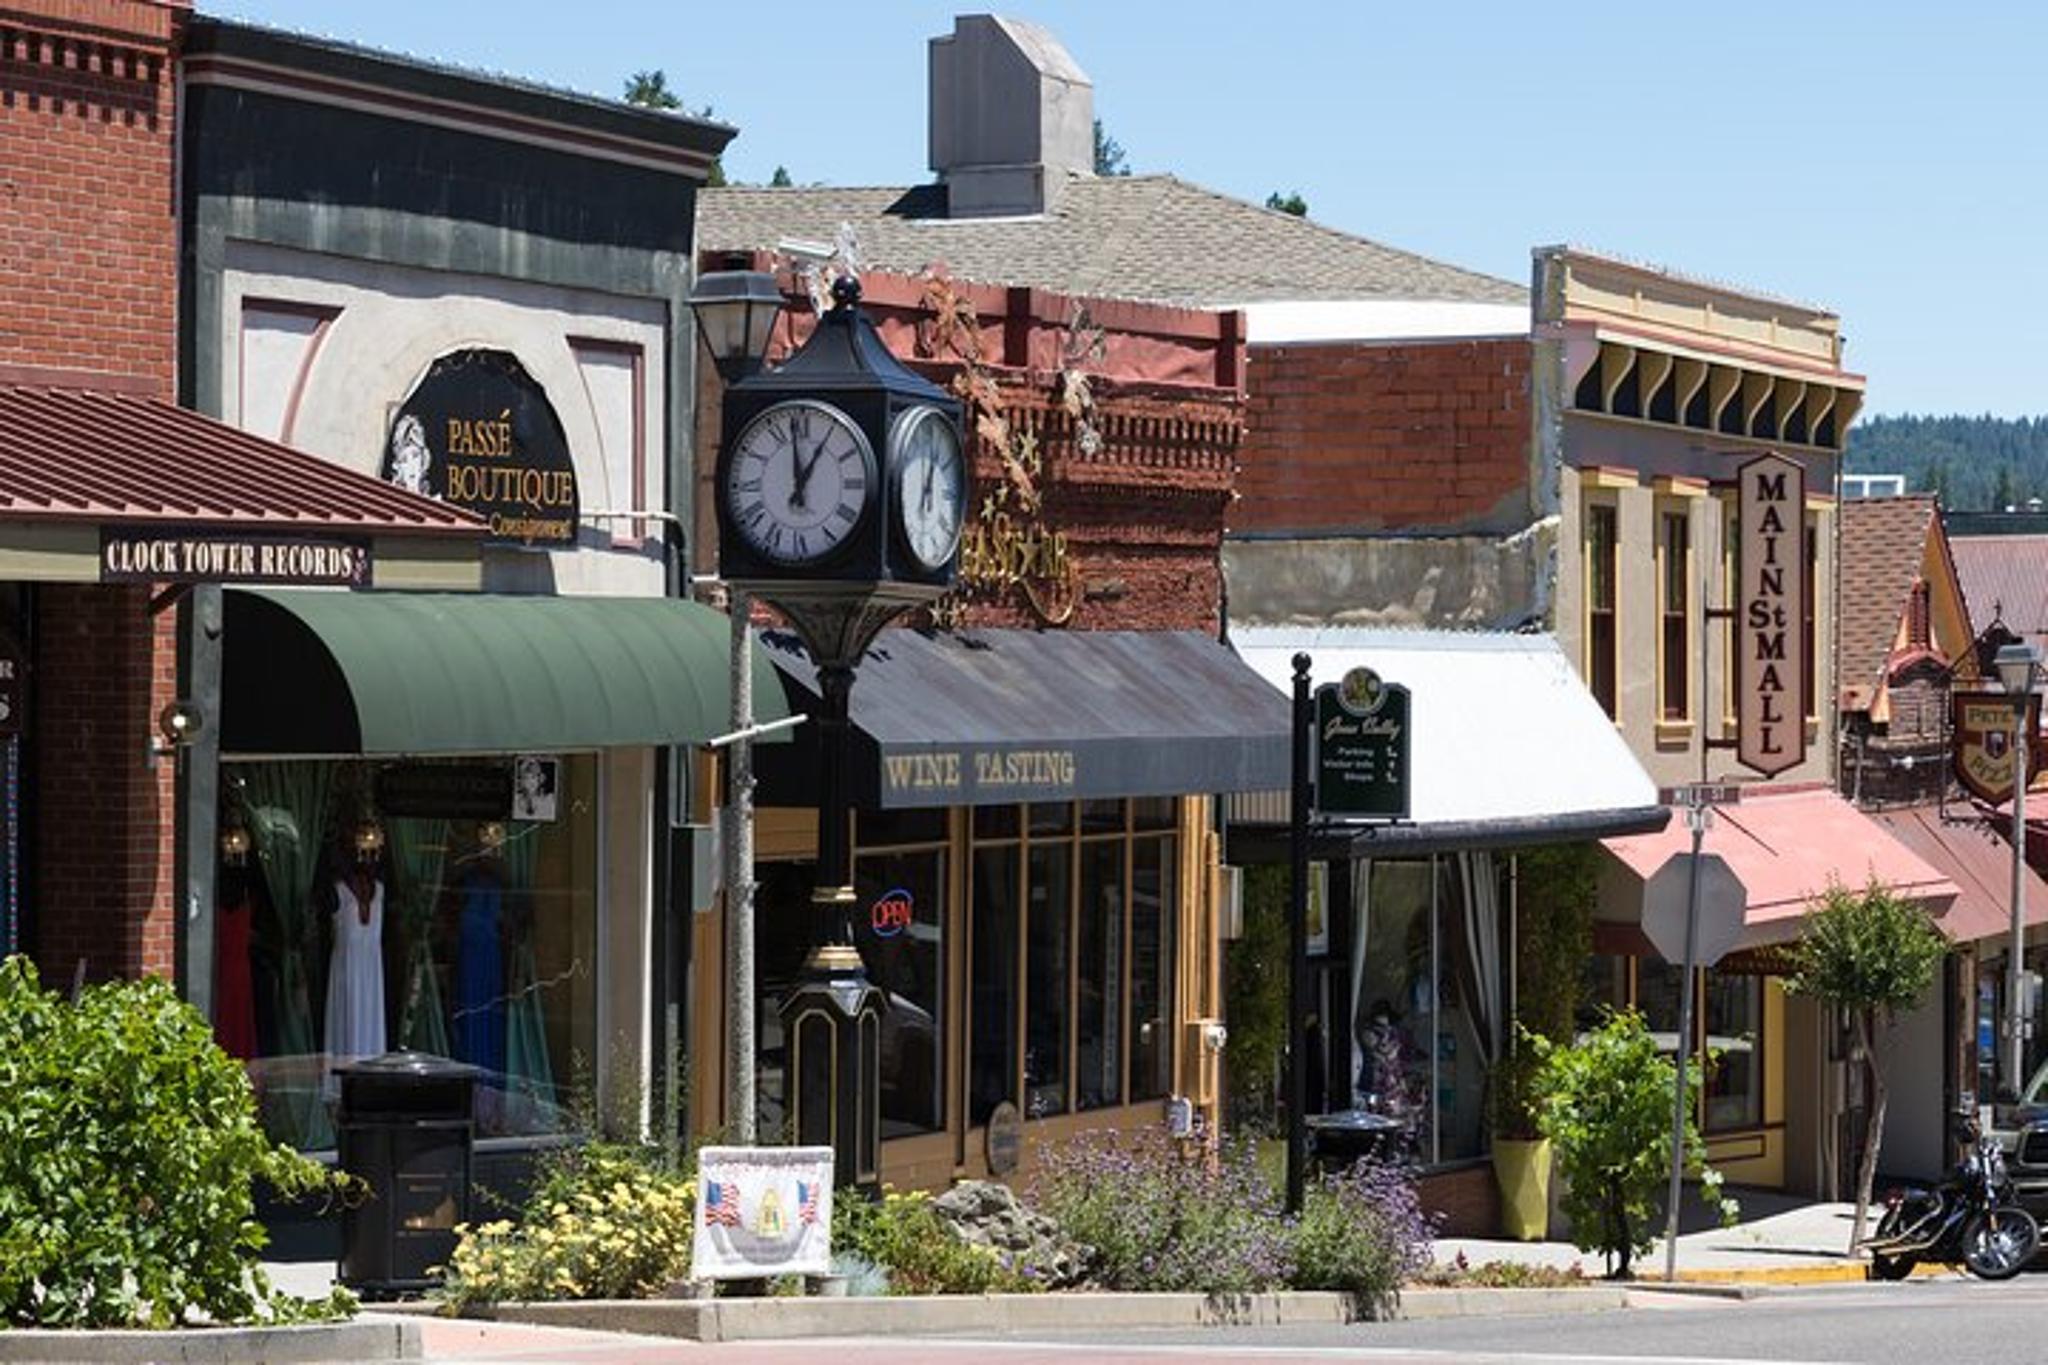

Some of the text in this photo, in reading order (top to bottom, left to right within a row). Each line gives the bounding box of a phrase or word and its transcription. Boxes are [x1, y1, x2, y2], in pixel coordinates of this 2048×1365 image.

[448, 408, 513, 457] PASSÉ
[448, 465, 574, 511] BOUTIQUE
[107, 540, 352, 578] CLOCK TOWER RECORDS
[1749, 473, 1787, 755] MAIN St MALL
[885, 750, 1075, 790] WINE TASTING
[872, 900, 912, 928] OPEN
